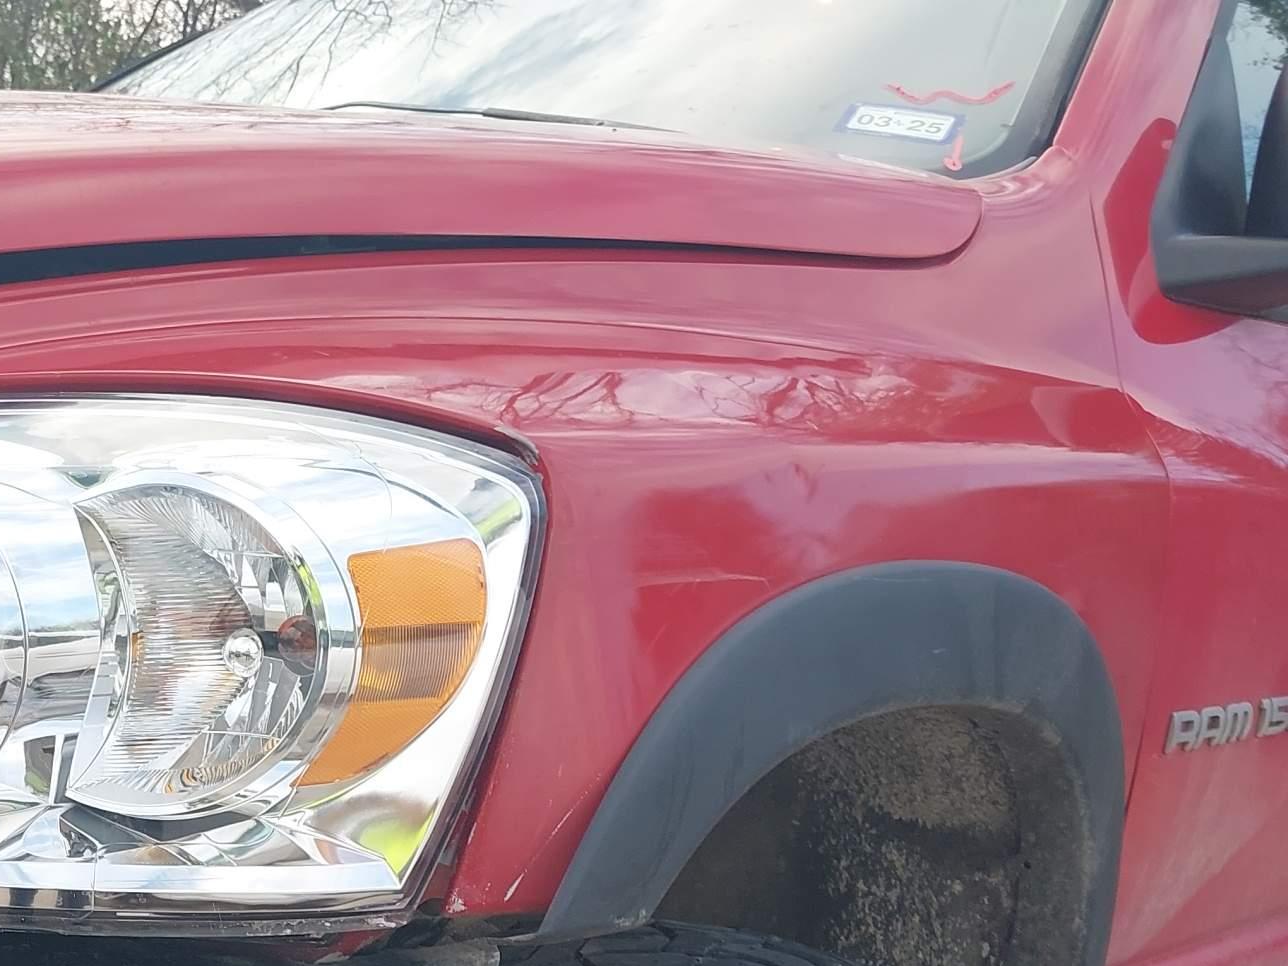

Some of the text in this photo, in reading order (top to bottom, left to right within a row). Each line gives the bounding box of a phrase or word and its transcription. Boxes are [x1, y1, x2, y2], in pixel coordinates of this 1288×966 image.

[856, 113, 892, 128] 03
[905, 119, 945, 134] 25
[1164, 702, 1254, 754] RAM
